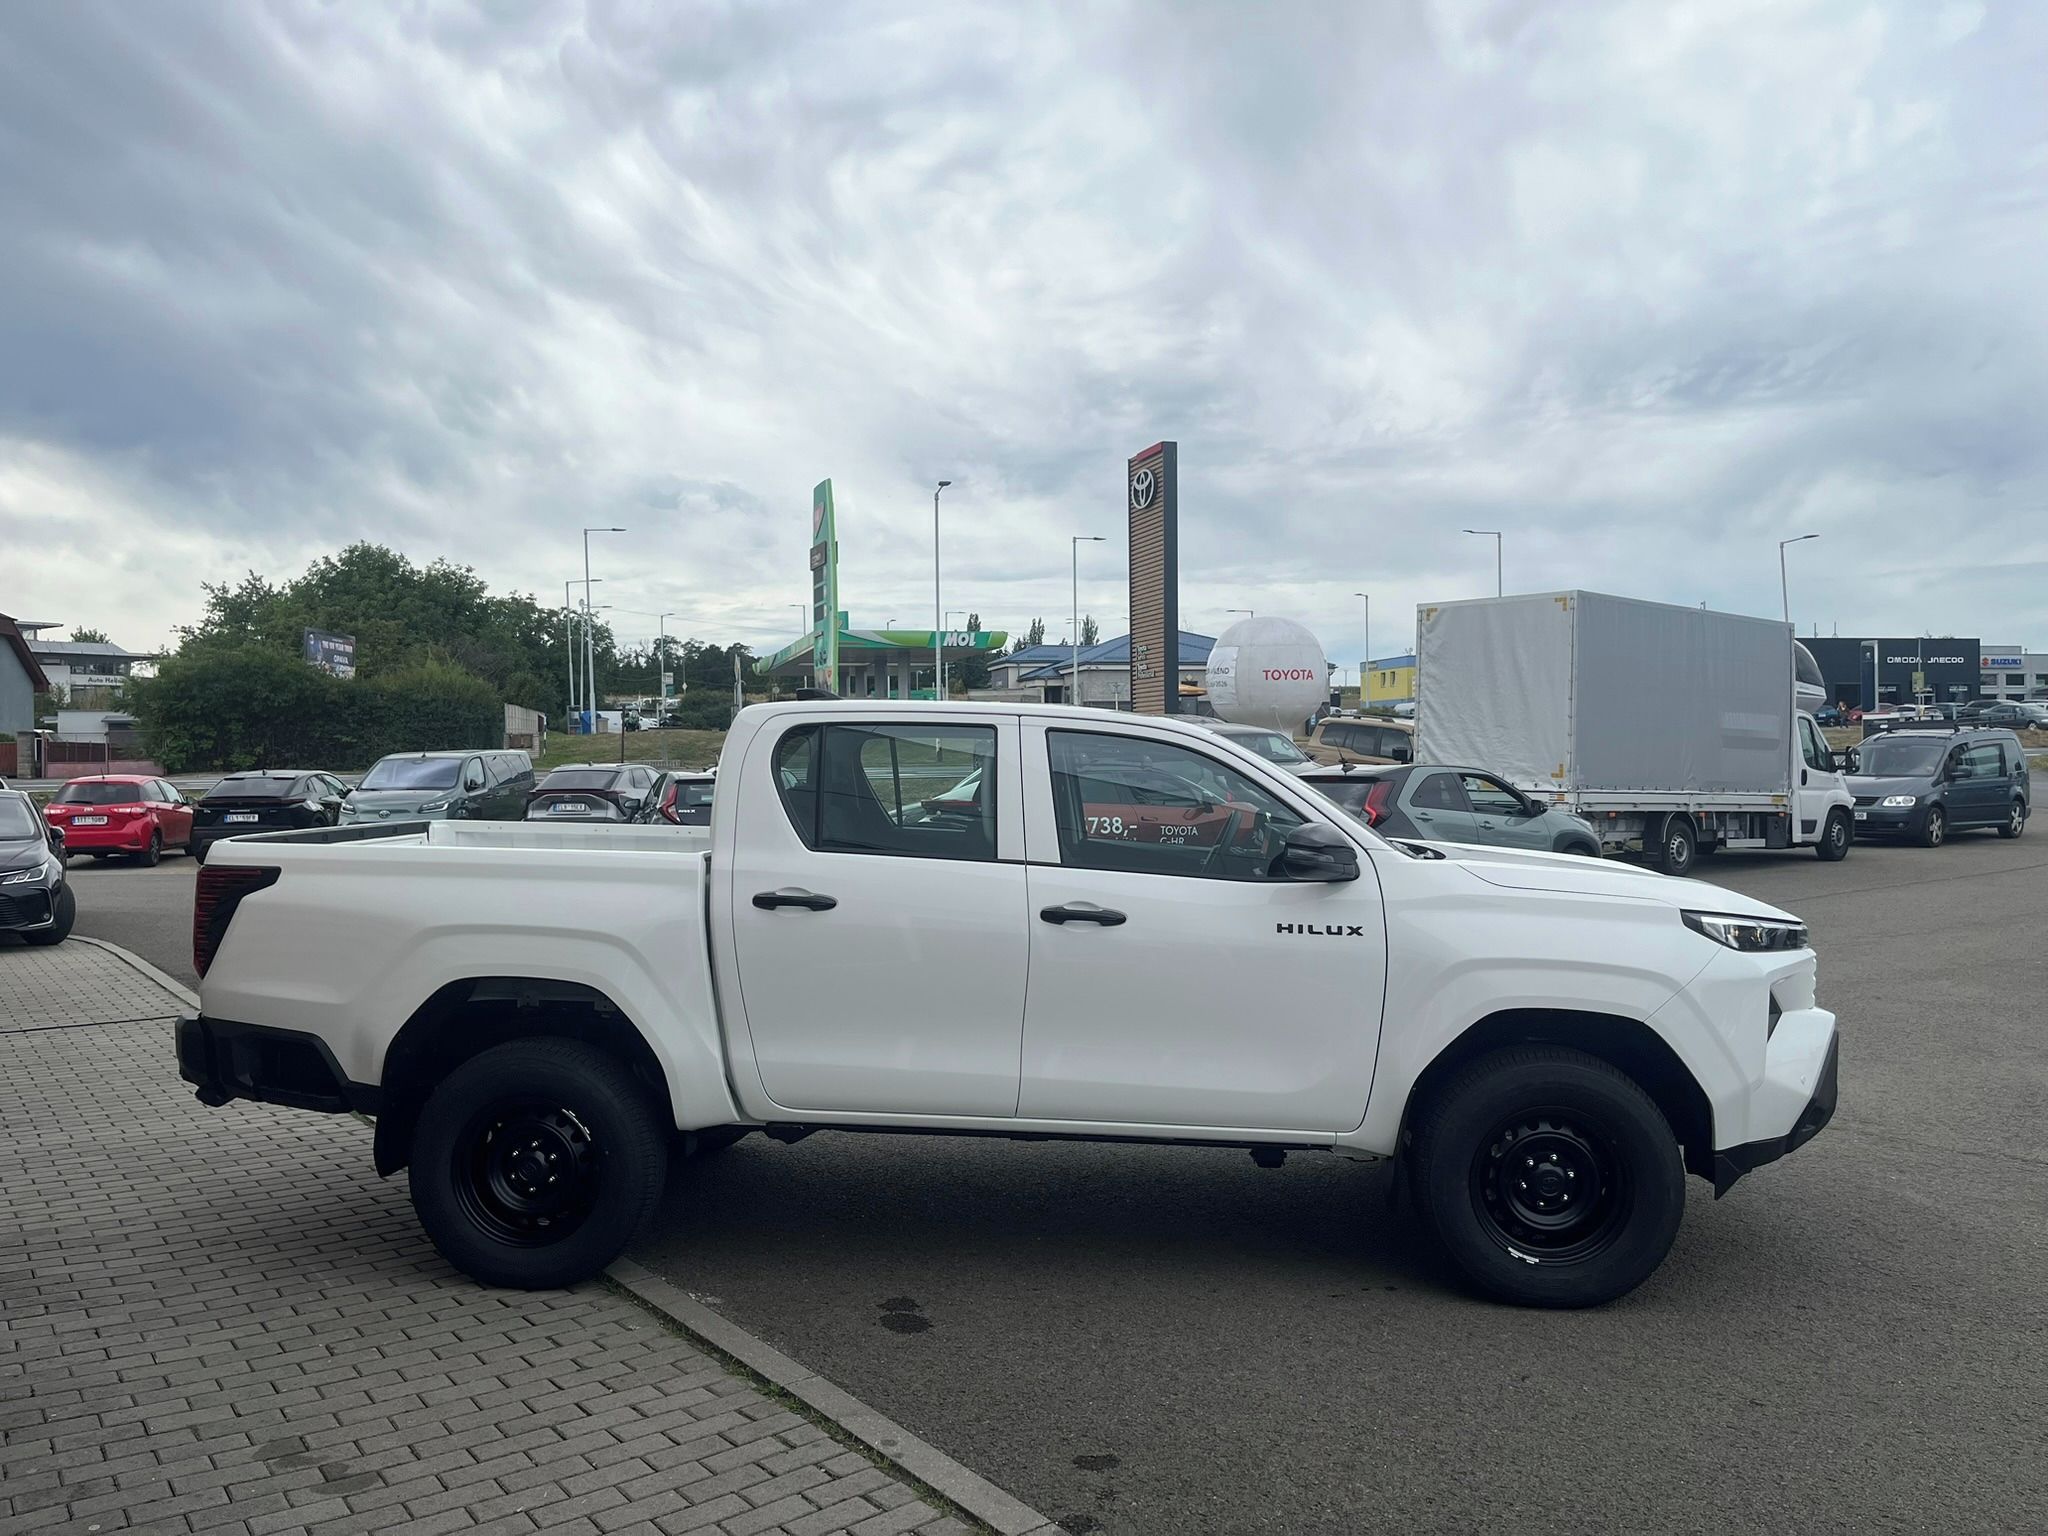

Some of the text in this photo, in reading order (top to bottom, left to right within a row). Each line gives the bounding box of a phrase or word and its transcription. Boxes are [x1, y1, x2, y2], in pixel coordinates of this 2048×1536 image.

[943, 632, 976, 647] MOL
[1887, 656, 1964, 664] OMODA JAECOO
[1262, 669, 1314, 681] TOYOTA
[1086, 816, 1137, 837] 738,-
[1160, 826, 1199, 836] TOYOTA
[1277, 923, 1364, 936] HILUX
